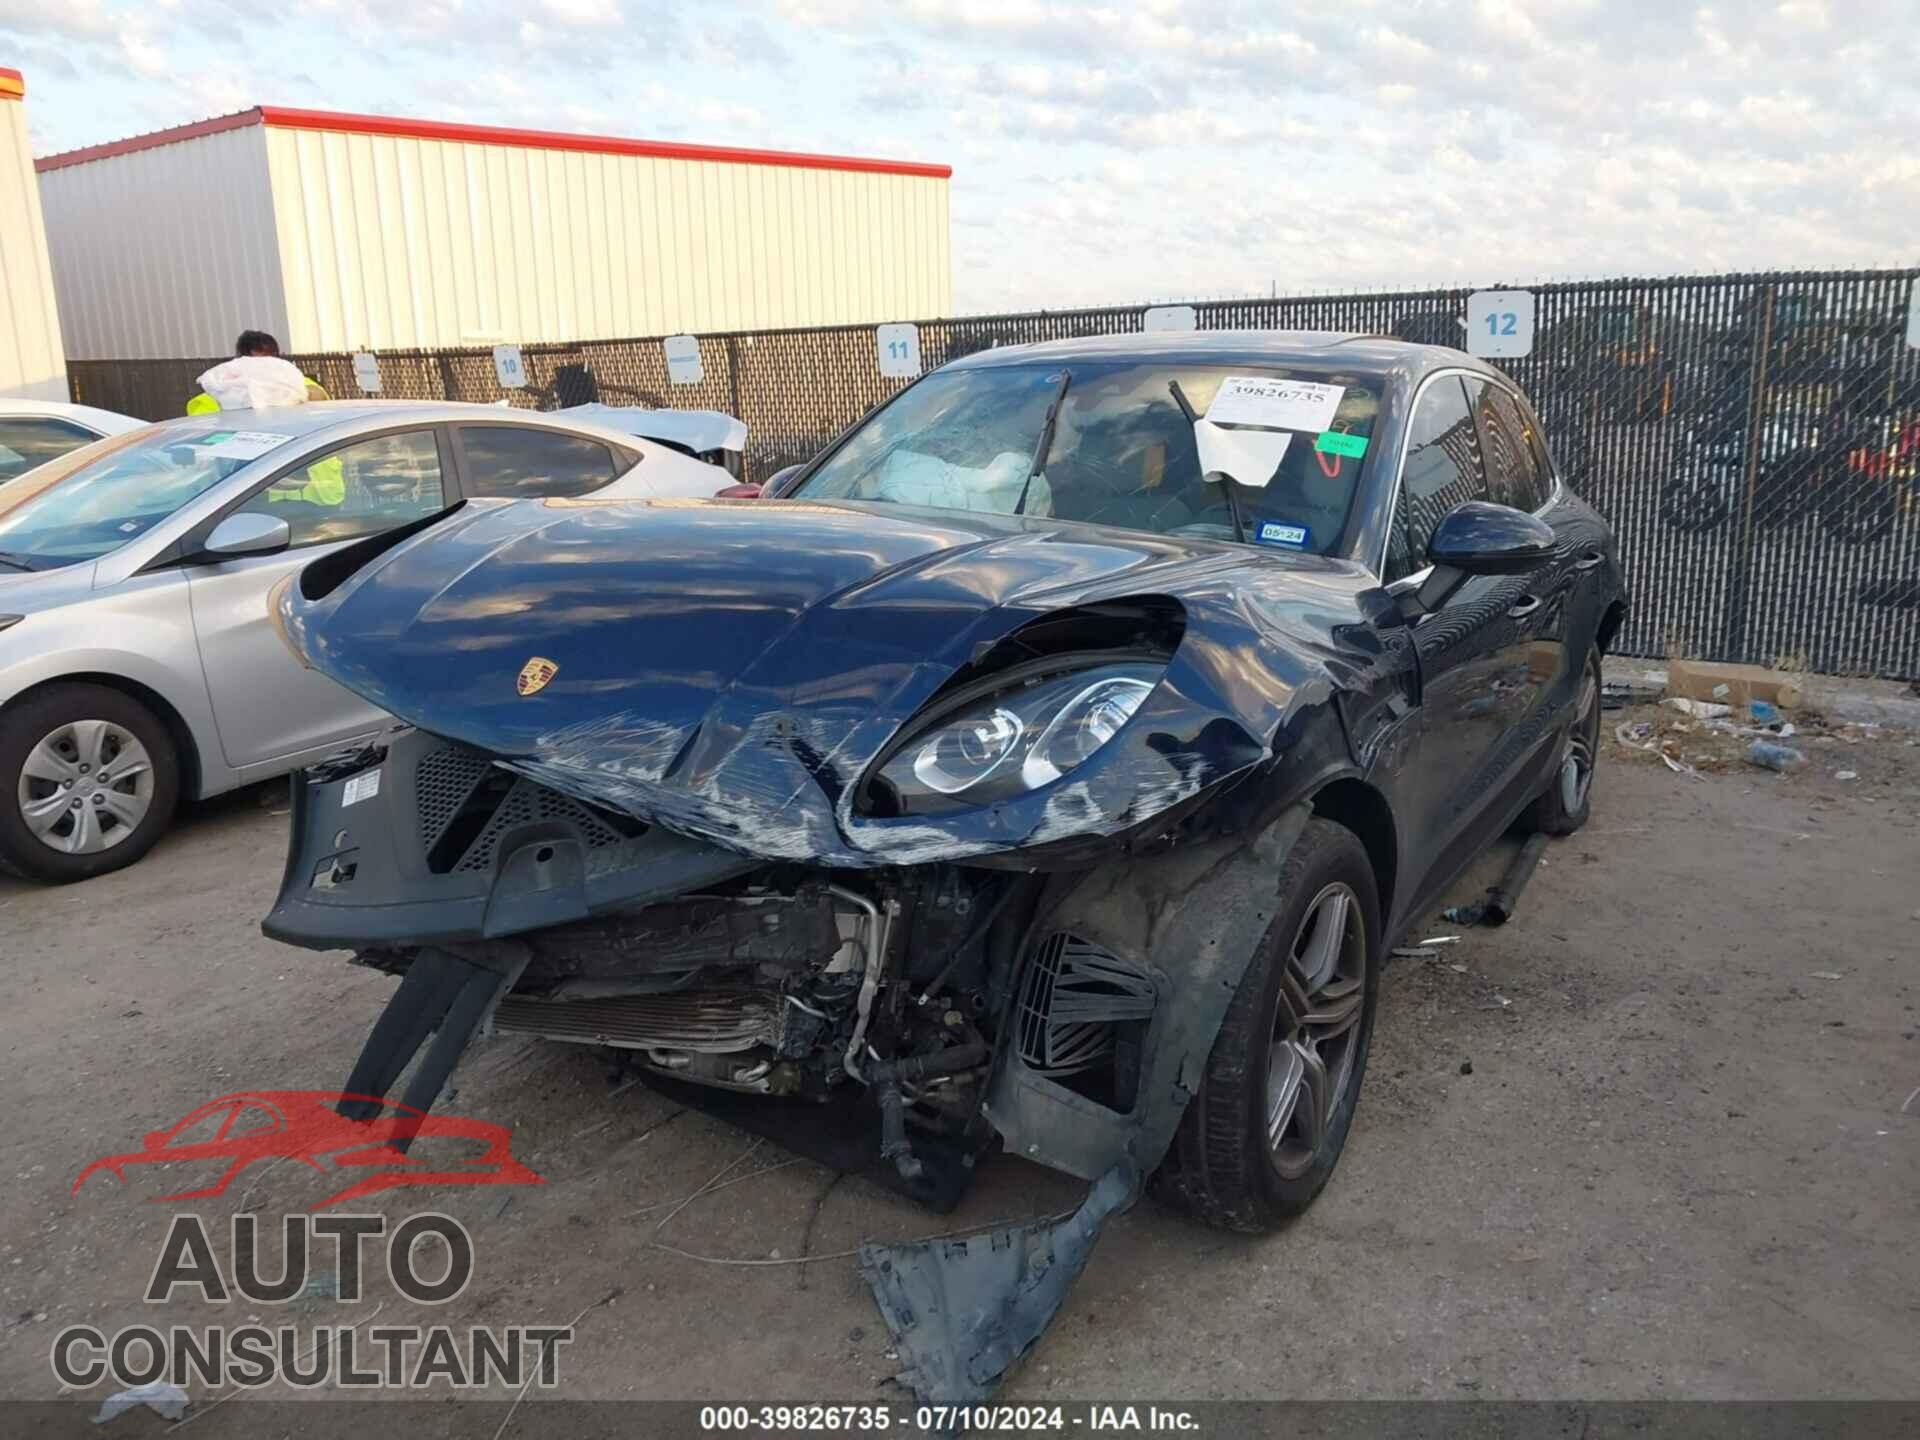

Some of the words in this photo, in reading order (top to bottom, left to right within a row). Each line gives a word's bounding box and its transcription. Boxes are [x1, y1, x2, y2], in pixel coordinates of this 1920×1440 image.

[1486, 313, 1517, 336] 12
[888, 341, 908, 359] 11
[502, 359, 516, 374] 10
[1231, 385, 1326, 402] 39826735
